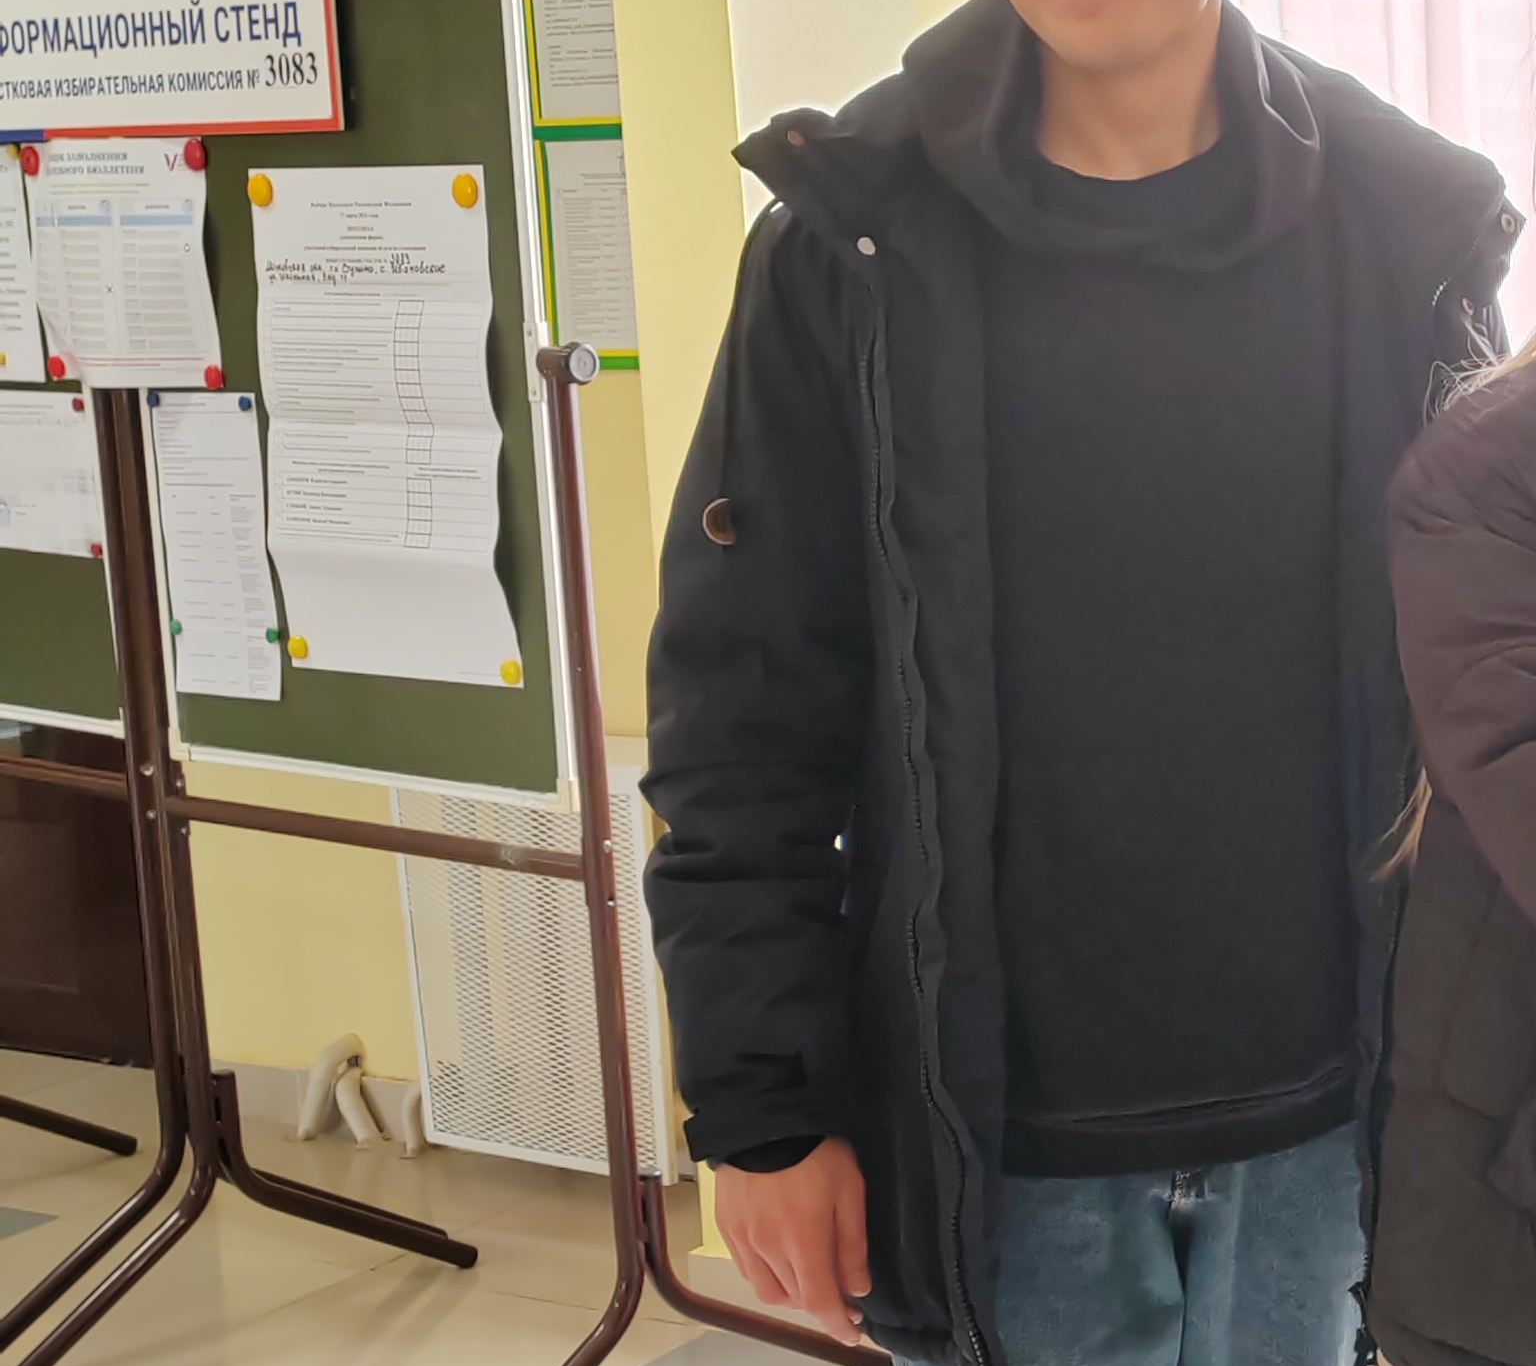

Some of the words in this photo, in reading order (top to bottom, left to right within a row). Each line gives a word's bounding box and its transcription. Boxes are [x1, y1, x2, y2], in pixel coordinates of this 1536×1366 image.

[214, 1, 301, 48] СТЕНД
[54, 73, 165, 99] ИЗБИРАТЕЛЬНАЯ
[168, 69, 243, 93] КОМИССИЯ
[264, 51, 318, 87] 3083
